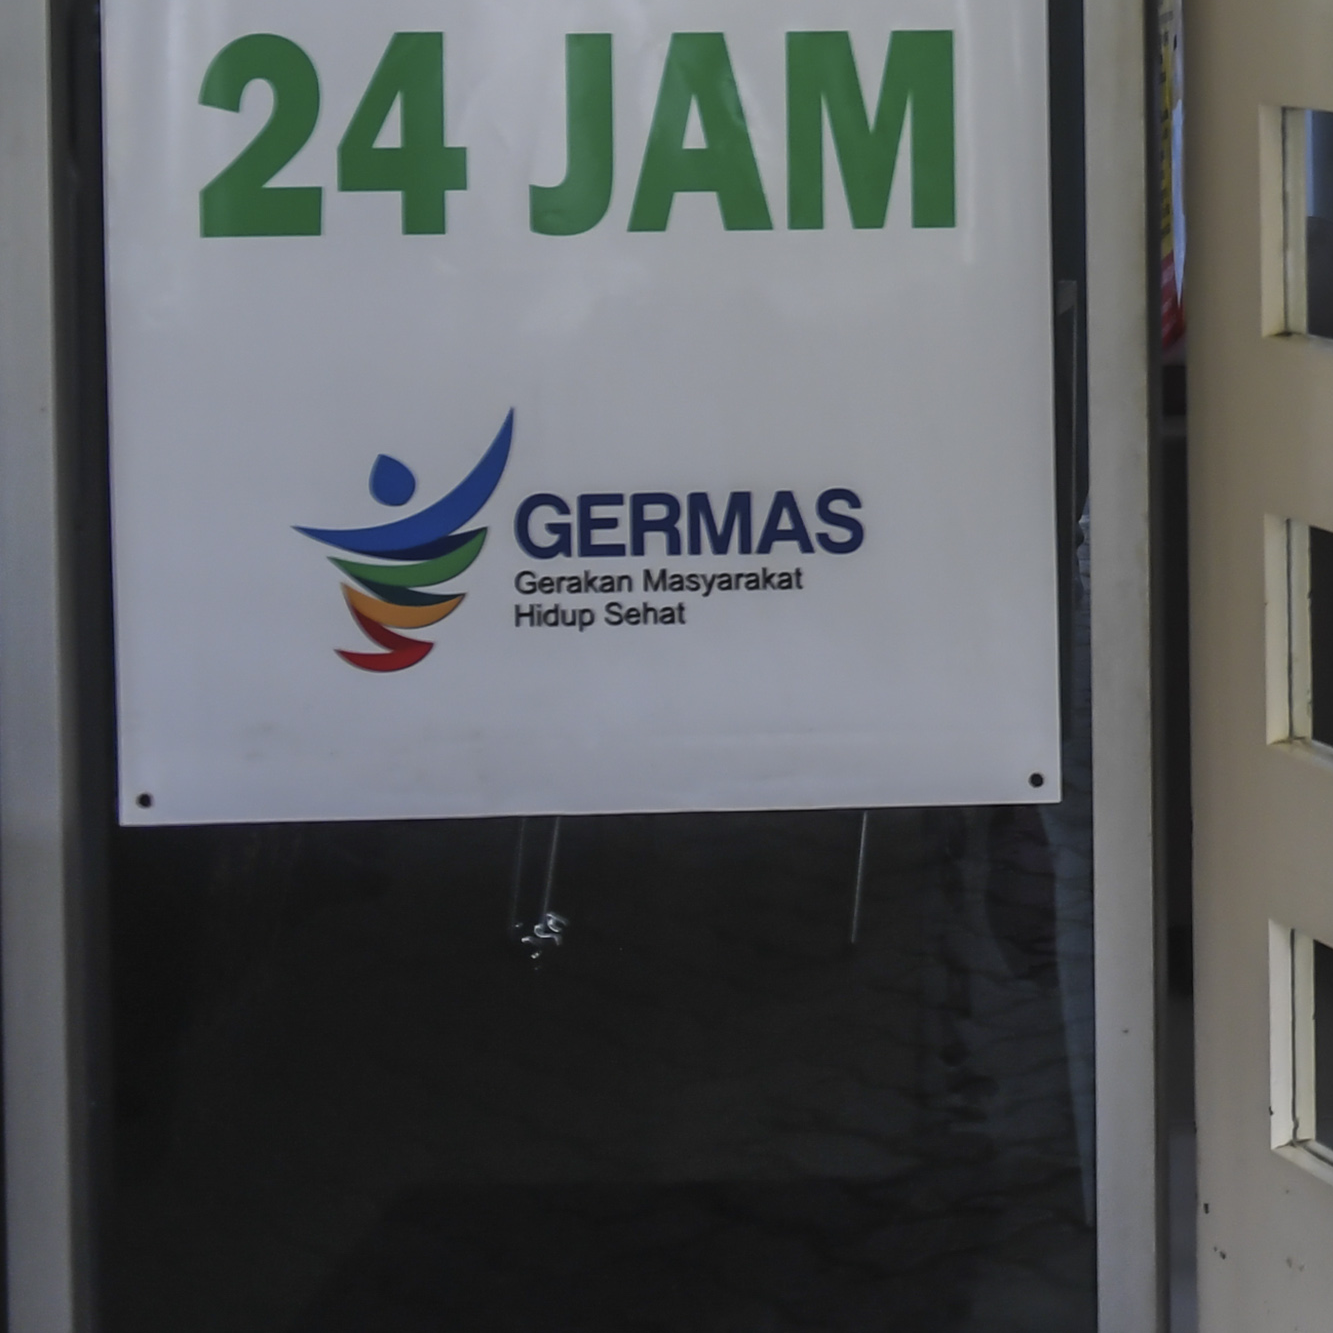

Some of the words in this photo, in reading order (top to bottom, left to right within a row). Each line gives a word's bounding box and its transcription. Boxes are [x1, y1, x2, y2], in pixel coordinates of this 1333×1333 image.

[198, 30, 468, 238] 24
[528, 28, 957, 236] JAM
[513, 488, 865, 560] GERMAS
[513, 570, 634, 596] Gerakan
[642, 566, 804, 598] Masyarakat
[513, 602, 596, 632] Hidup
[604, 600, 687, 627] Sehat
